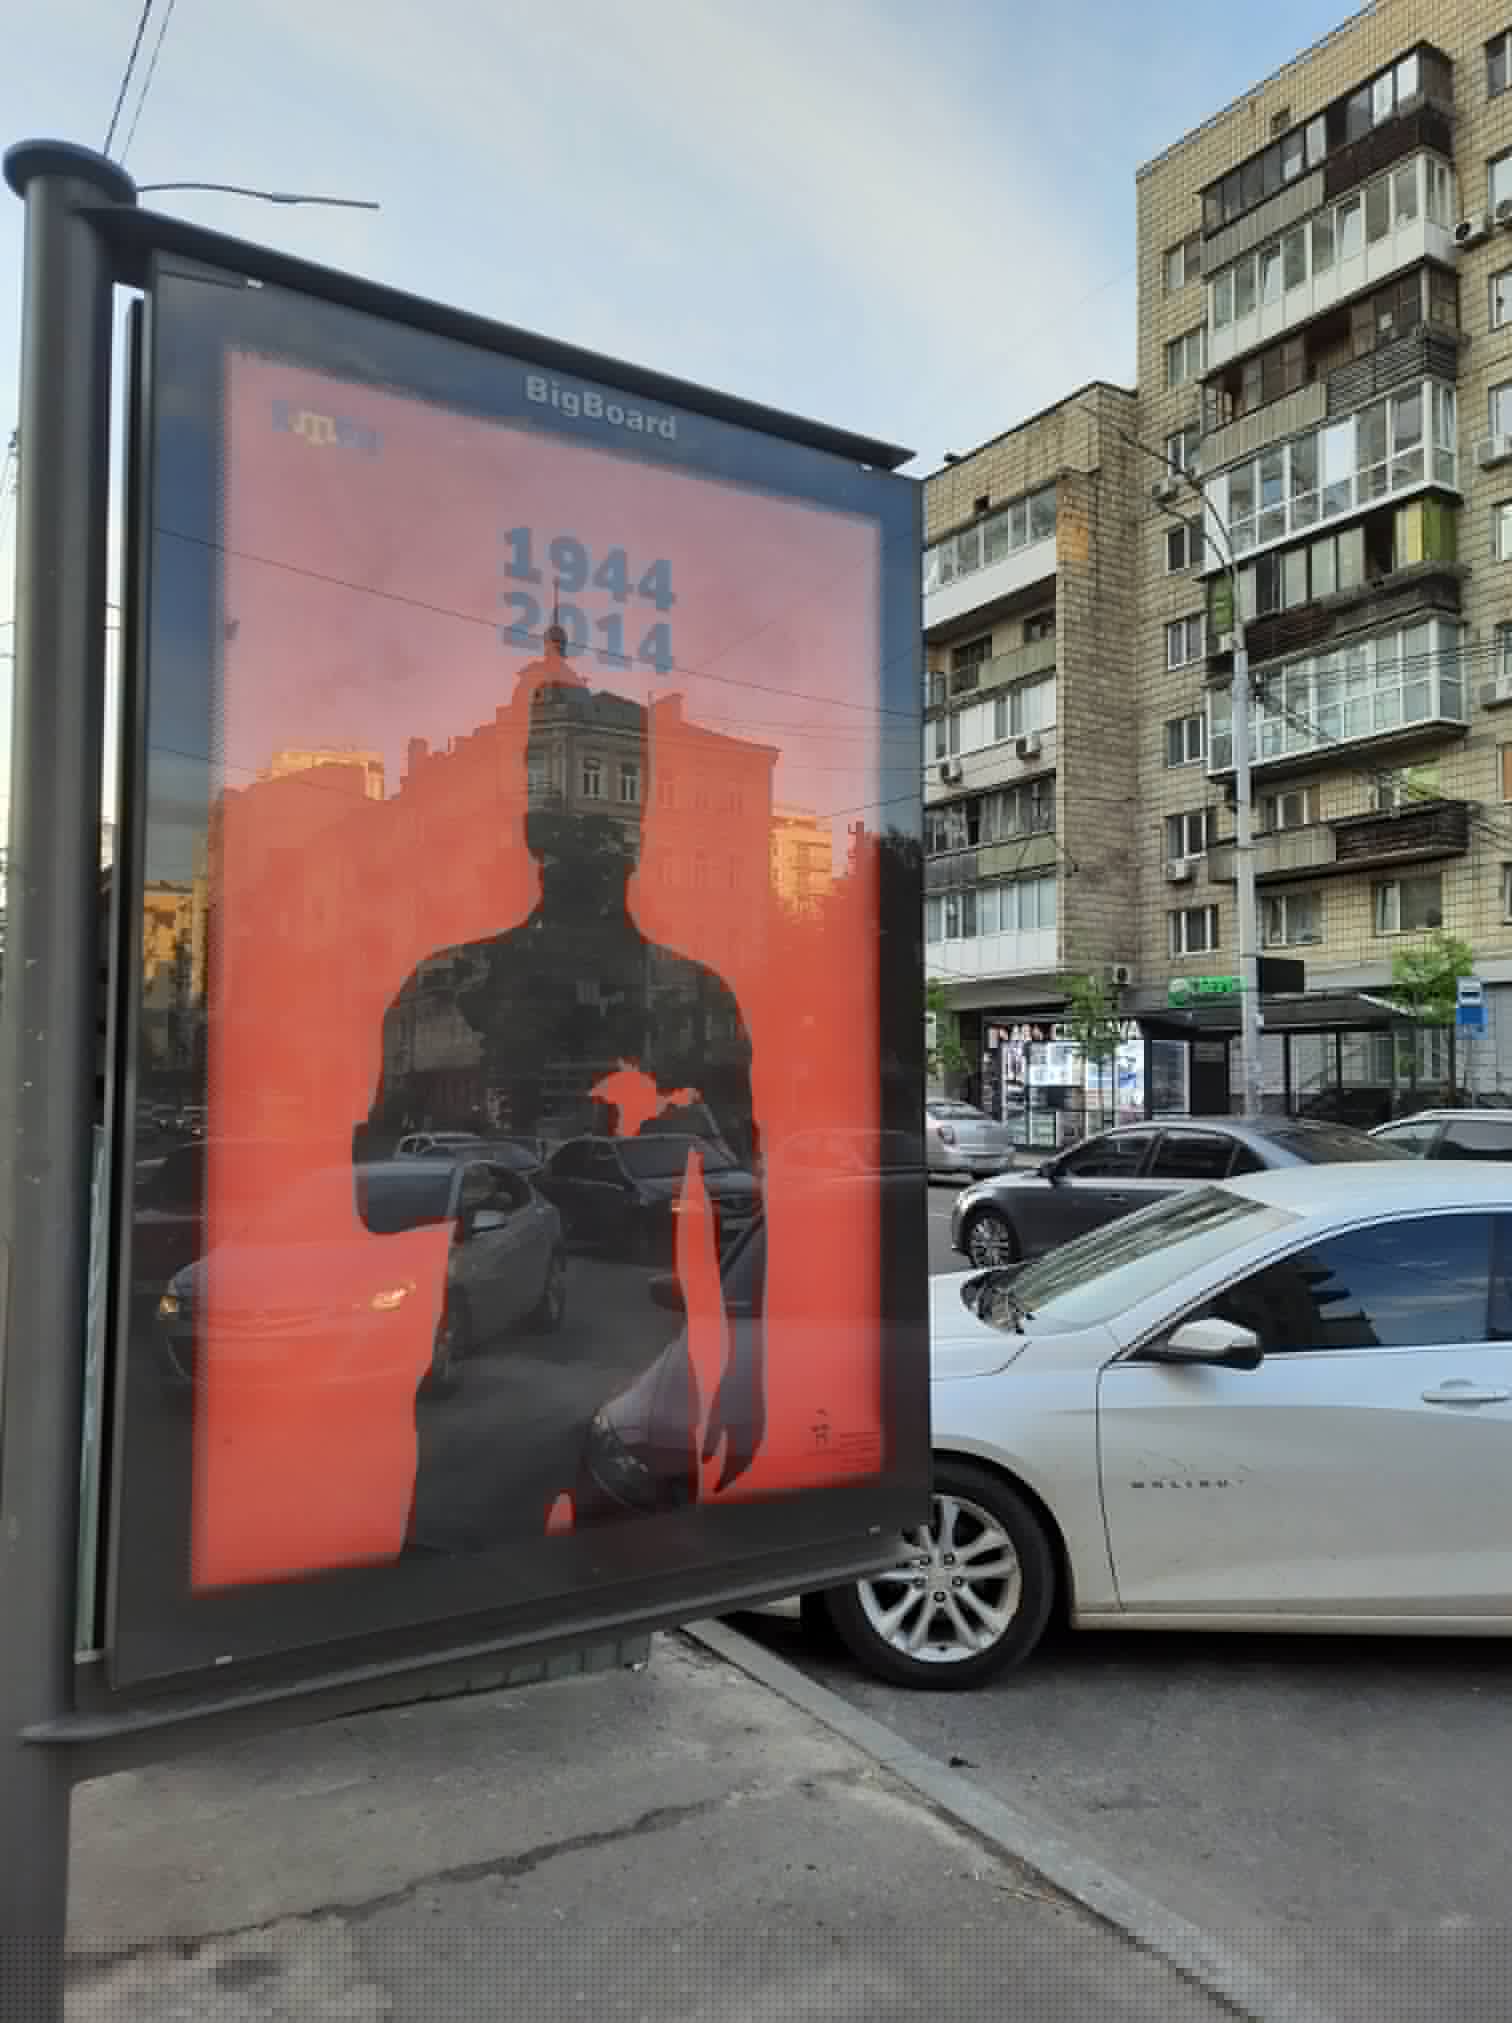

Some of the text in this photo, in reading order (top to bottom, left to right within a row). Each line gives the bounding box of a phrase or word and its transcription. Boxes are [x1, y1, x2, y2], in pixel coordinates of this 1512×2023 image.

[525, 374, 677, 441] BigBoard
[503, 525, 676, 612] 1944
[503, 591, 675, 673] 2014
